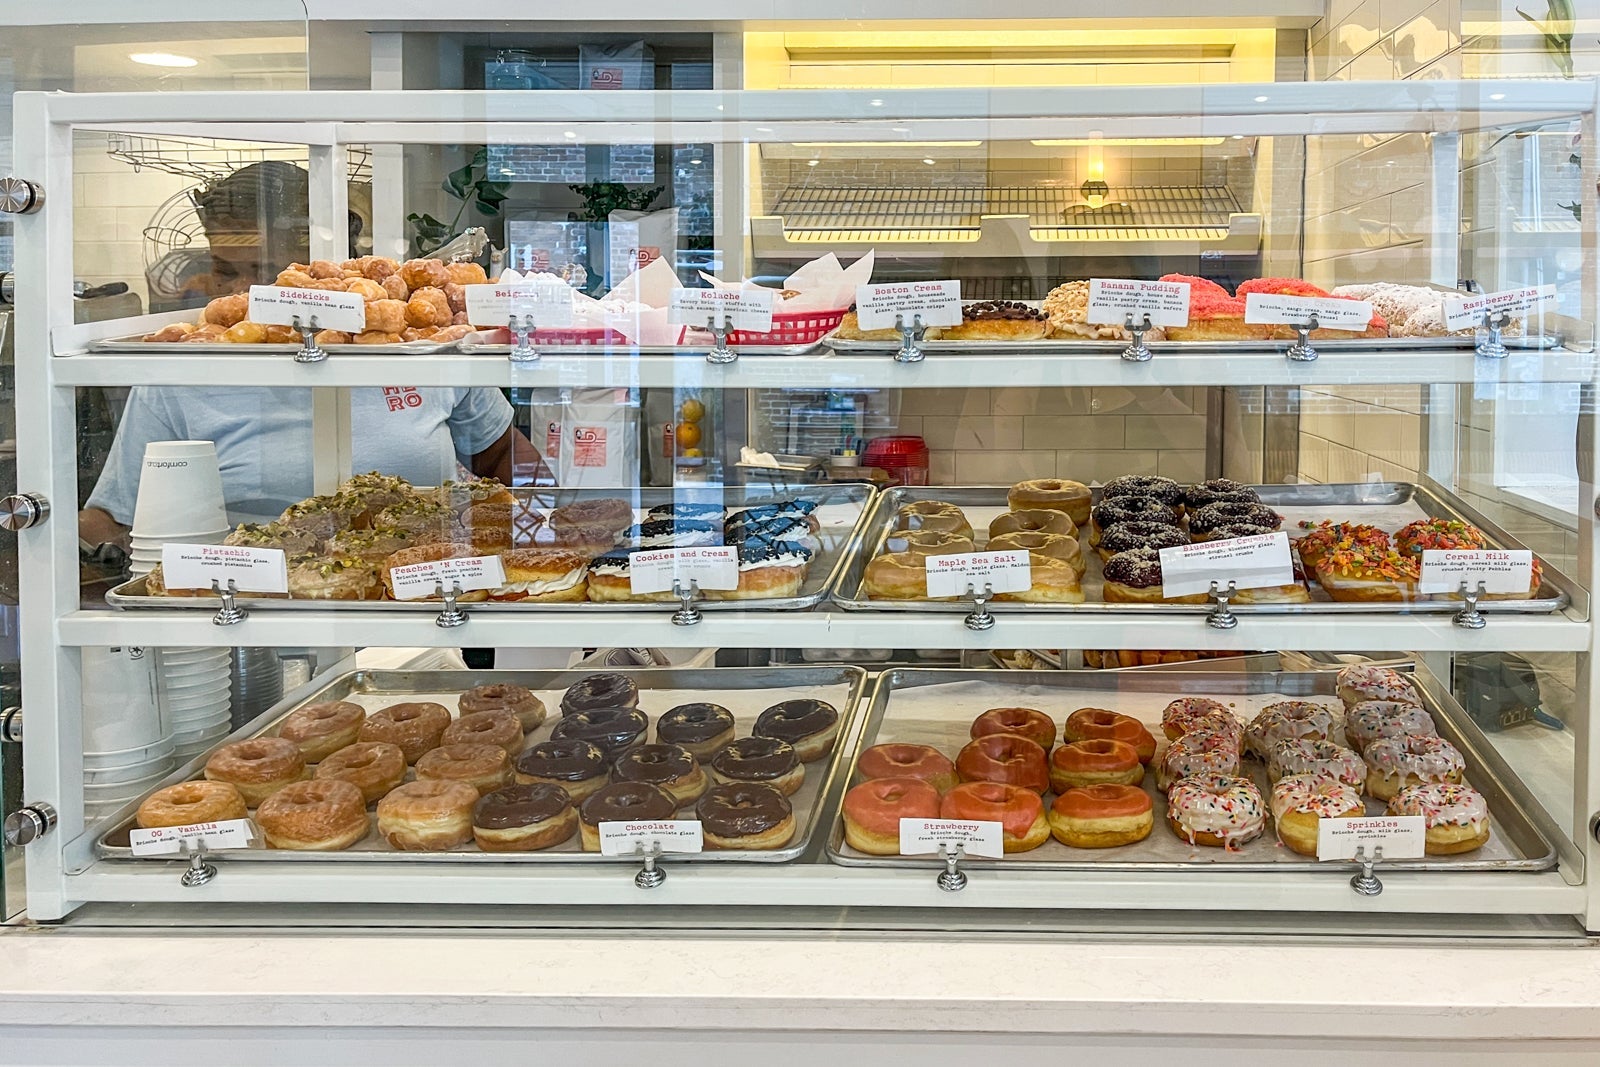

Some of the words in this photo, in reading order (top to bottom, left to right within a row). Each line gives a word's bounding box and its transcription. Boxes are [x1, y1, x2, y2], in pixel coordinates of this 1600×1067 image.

[875, 286, 908, 295] Boston
[914, 284, 942, 292] Cream
[1101, 282, 1134, 290] Banana
[1141, 284, 1181, 294] Pudding
[280, 291, 330, 301] Sidekicks
[702, 292, 740, 300] Kolache
[1463, 294, 1514, 310] Raspberry
[1520, 289, 1538, 297] Jam
[386, 393, 422, 411] RO
[1183, 540, 1232, 552] Blueberry
[1237, 534, 1274, 545] Crumble
[203, 548, 250, 557] Pistachio
[636, 554, 674, 562] Cookies
[938, 559, 966, 567] Maple
[395, 565, 433, 574] Peaches
[178, 824, 217, 833] Vanilla
[626, 823, 675, 831] Chocolate
[924, 824, 980, 832] Strawberry
[1347, 821, 1398, 830] Sprinkles
